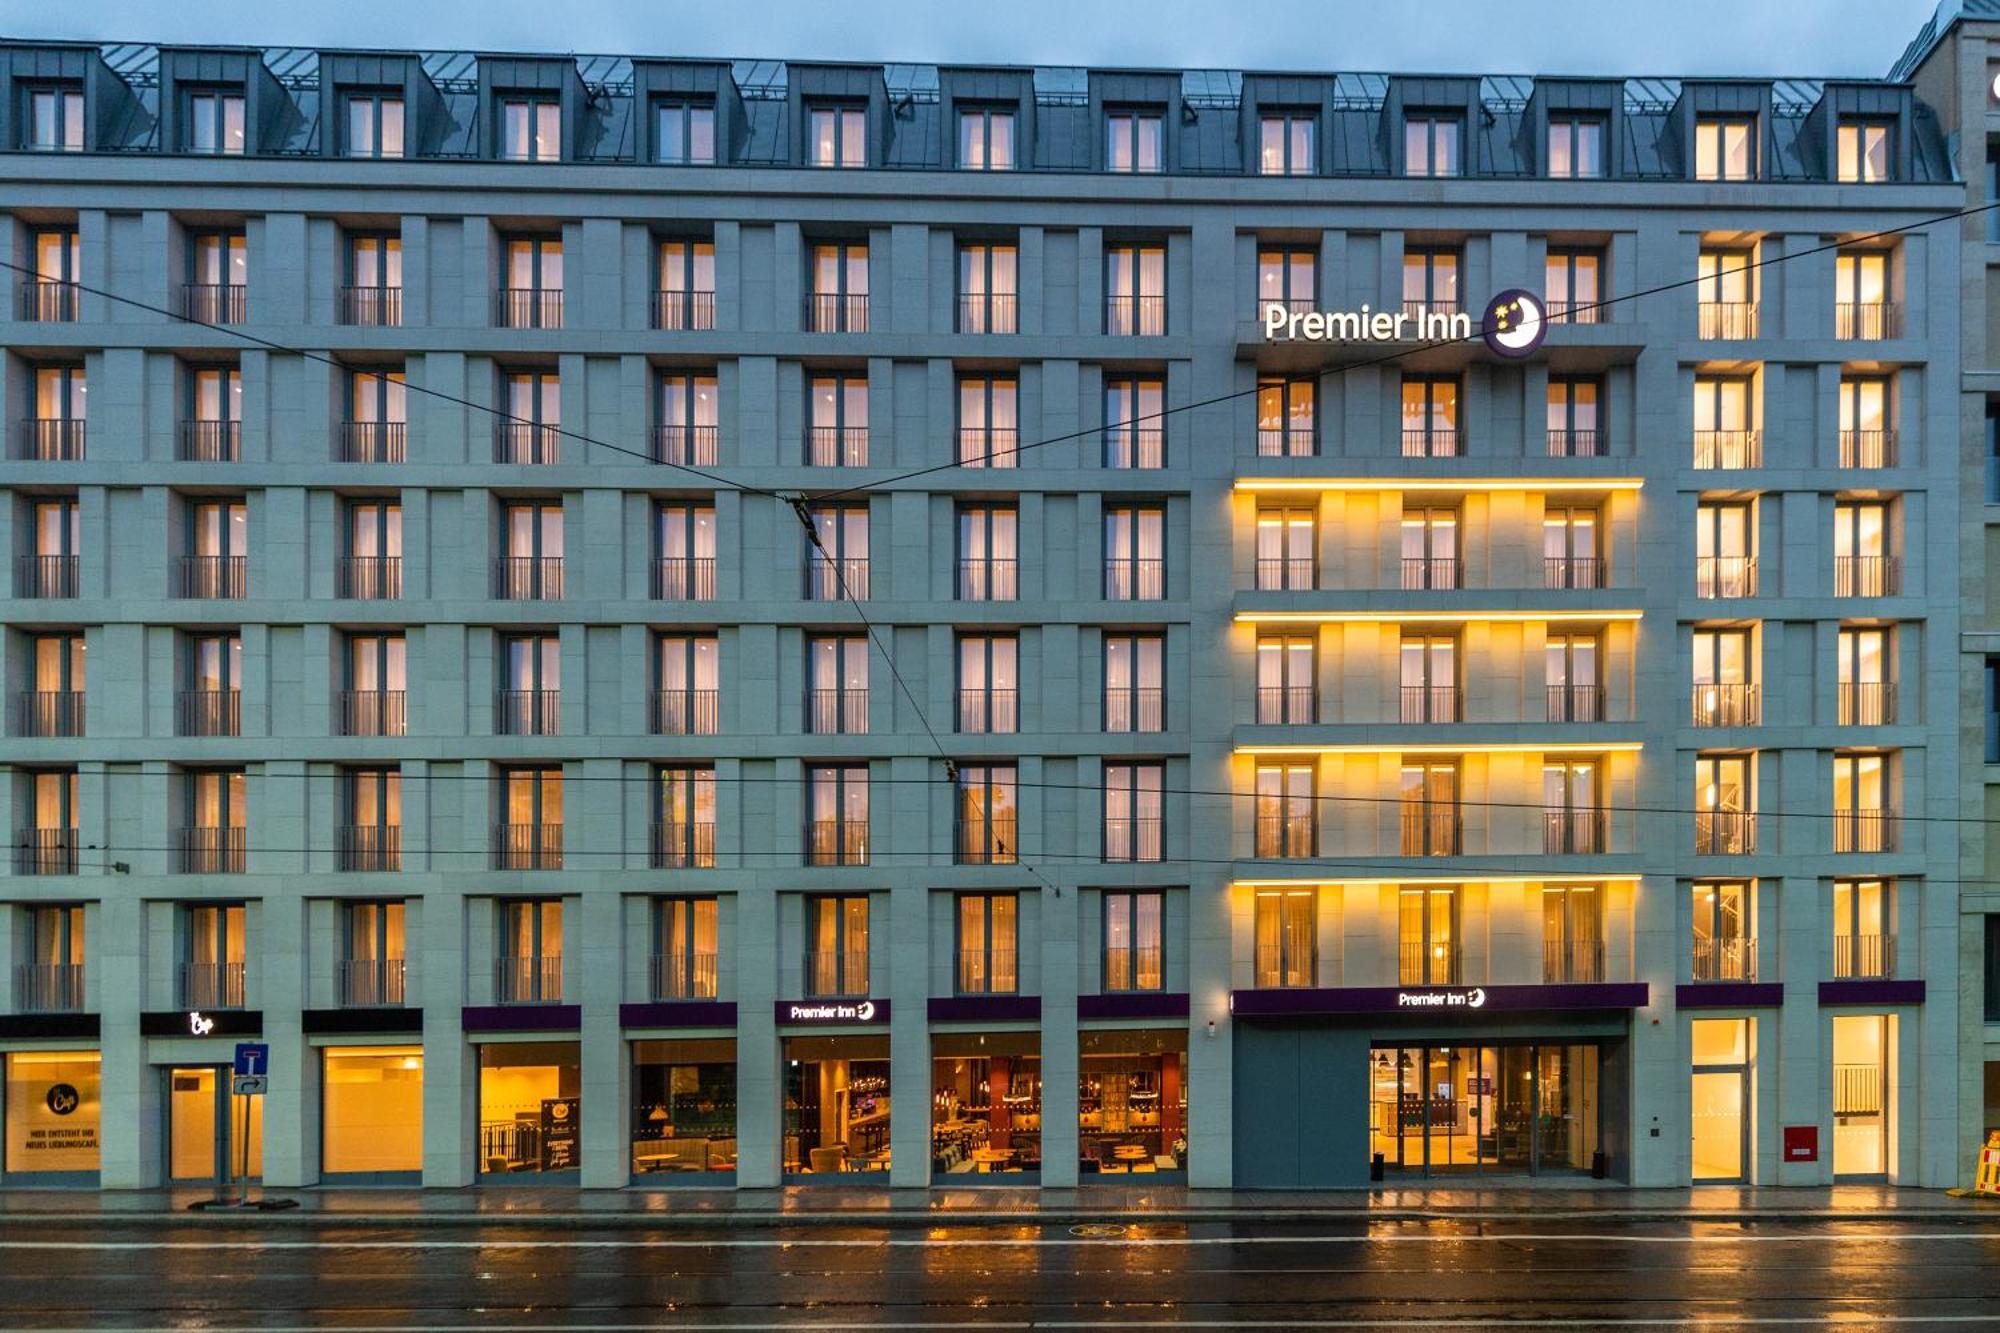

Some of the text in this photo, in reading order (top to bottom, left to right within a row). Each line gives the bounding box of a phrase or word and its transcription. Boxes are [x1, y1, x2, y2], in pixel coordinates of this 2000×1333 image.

[1265, 304, 1470, 340] Premier Inn
[1399, 993, 1465, 1006] Premier Inn
[791, 1005, 856, 1018] Premier Inn
